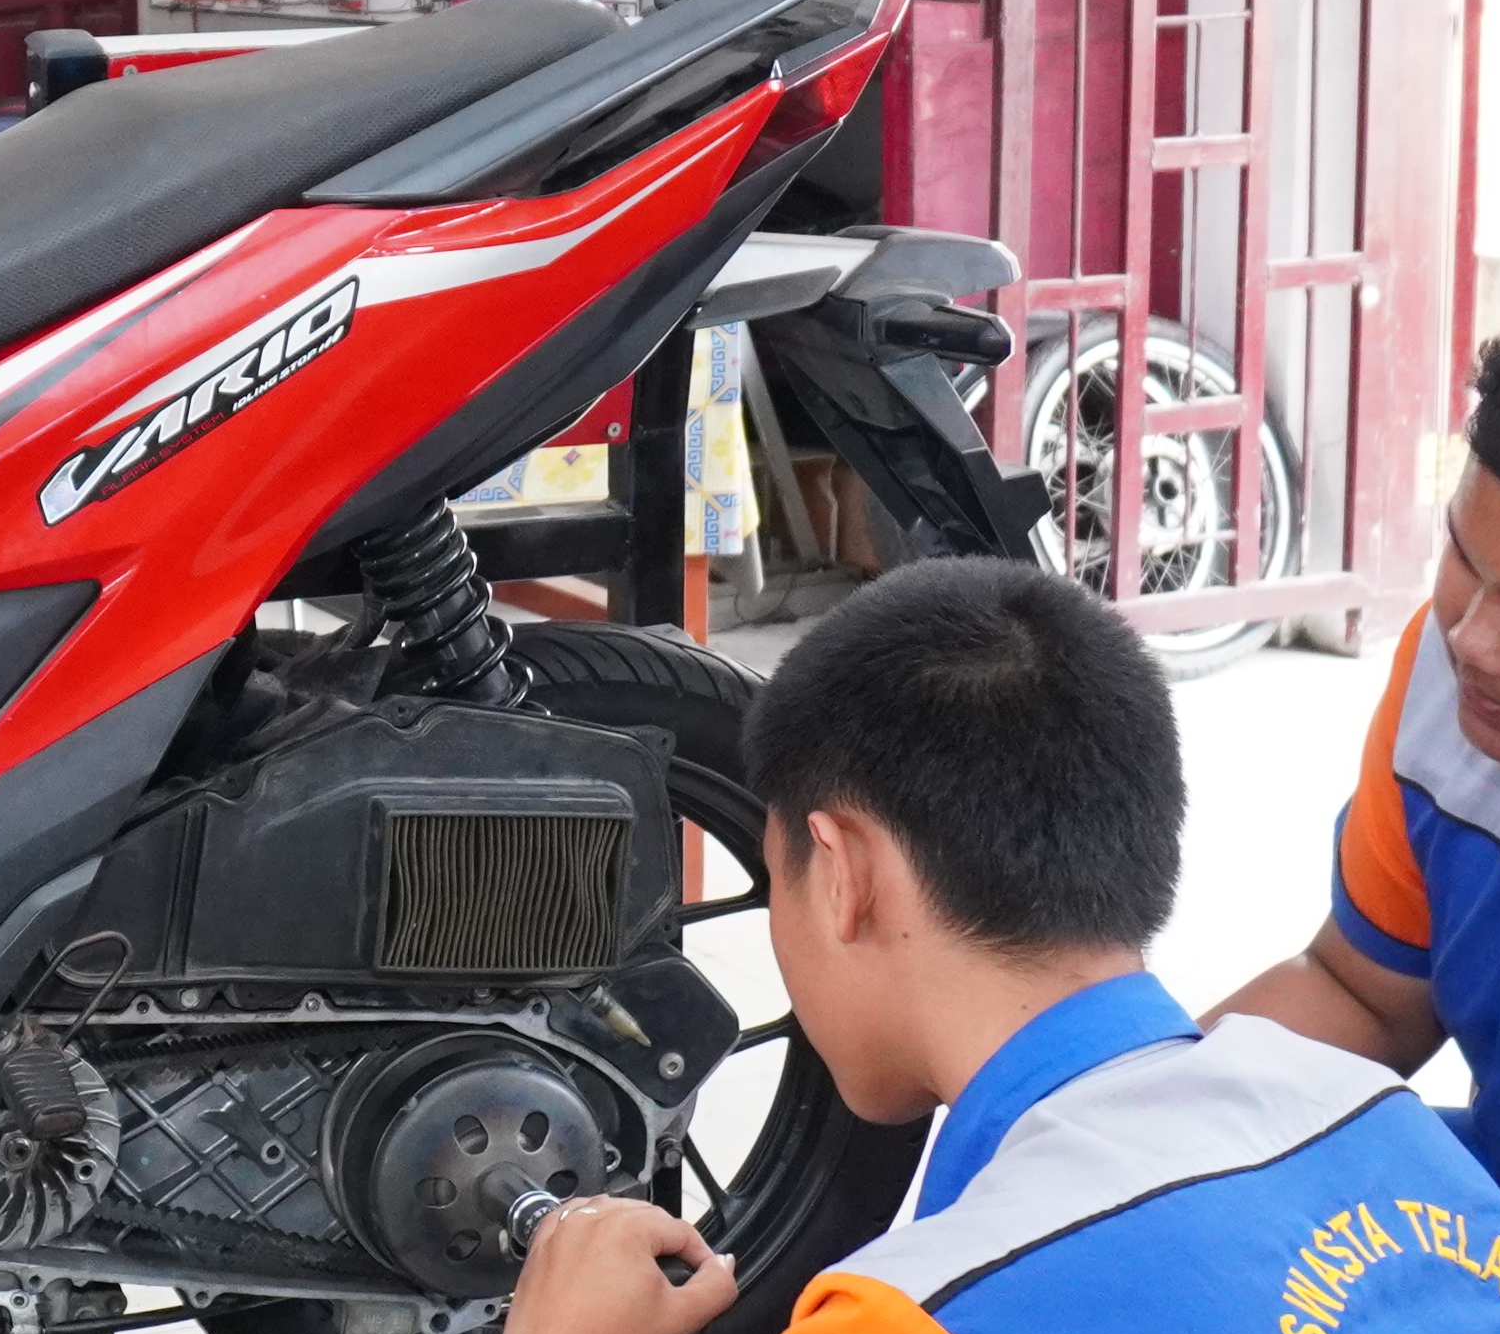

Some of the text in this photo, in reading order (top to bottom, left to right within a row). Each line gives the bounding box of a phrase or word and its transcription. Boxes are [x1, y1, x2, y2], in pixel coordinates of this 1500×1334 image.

[39, 277, 357, 527] VARIO
[233, 347, 319, 412] IDLING STOP
[159, 411, 225, 460] SYSTEM
